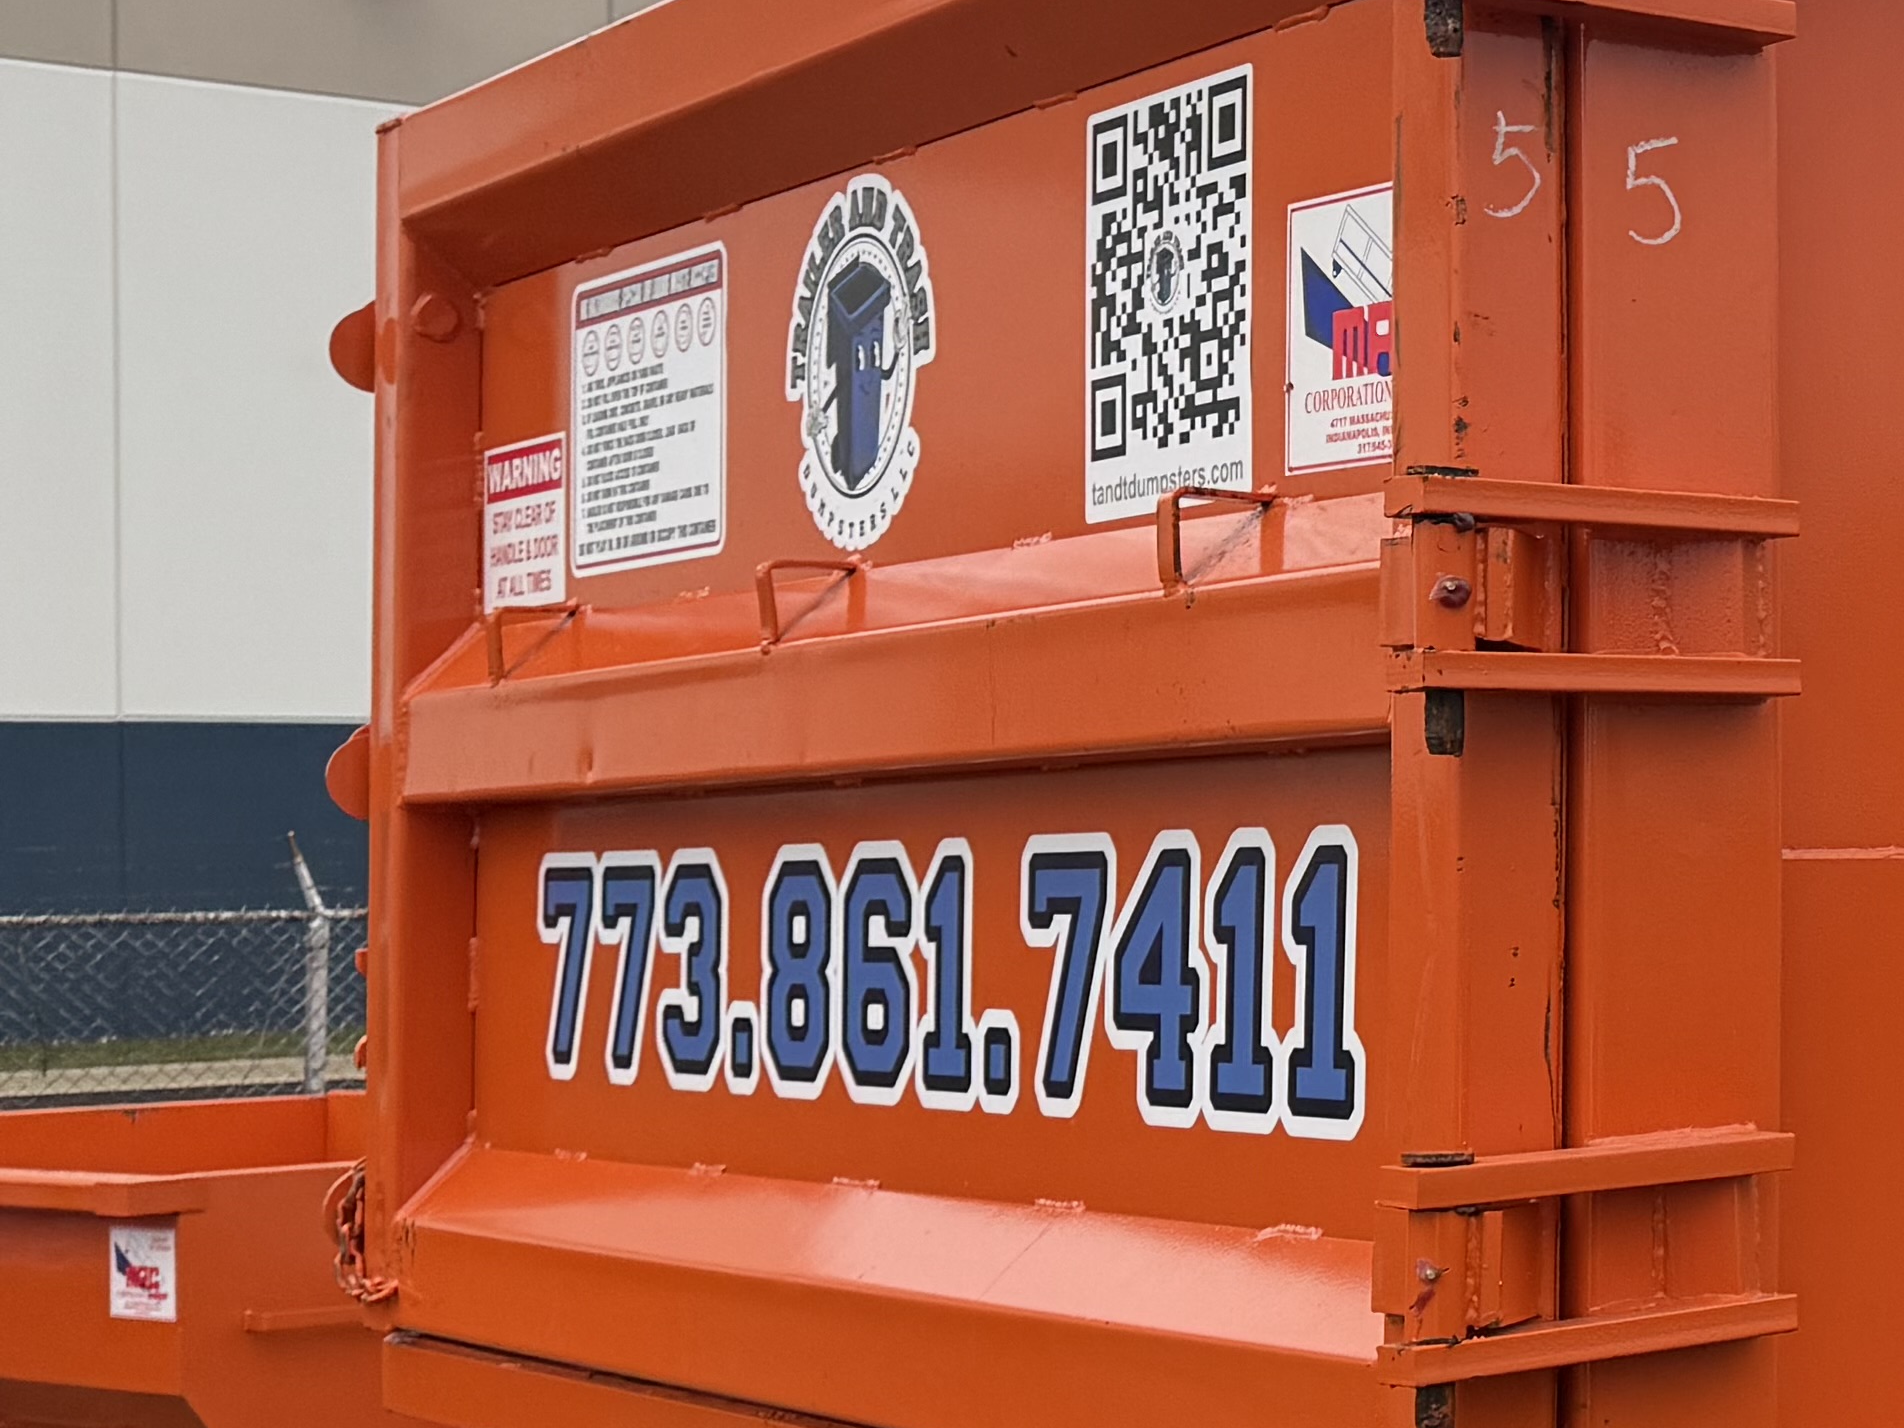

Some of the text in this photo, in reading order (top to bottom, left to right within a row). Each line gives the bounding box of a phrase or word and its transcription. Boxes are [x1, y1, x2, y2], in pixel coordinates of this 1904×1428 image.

[1484, 112, 1682, 245] 5 5
[486, 447, 562, 494] WARNING
[1092, 459, 1244, 506] tandtdumpsters.com
[538, 826, 1364, 1138] 773.861.7411
